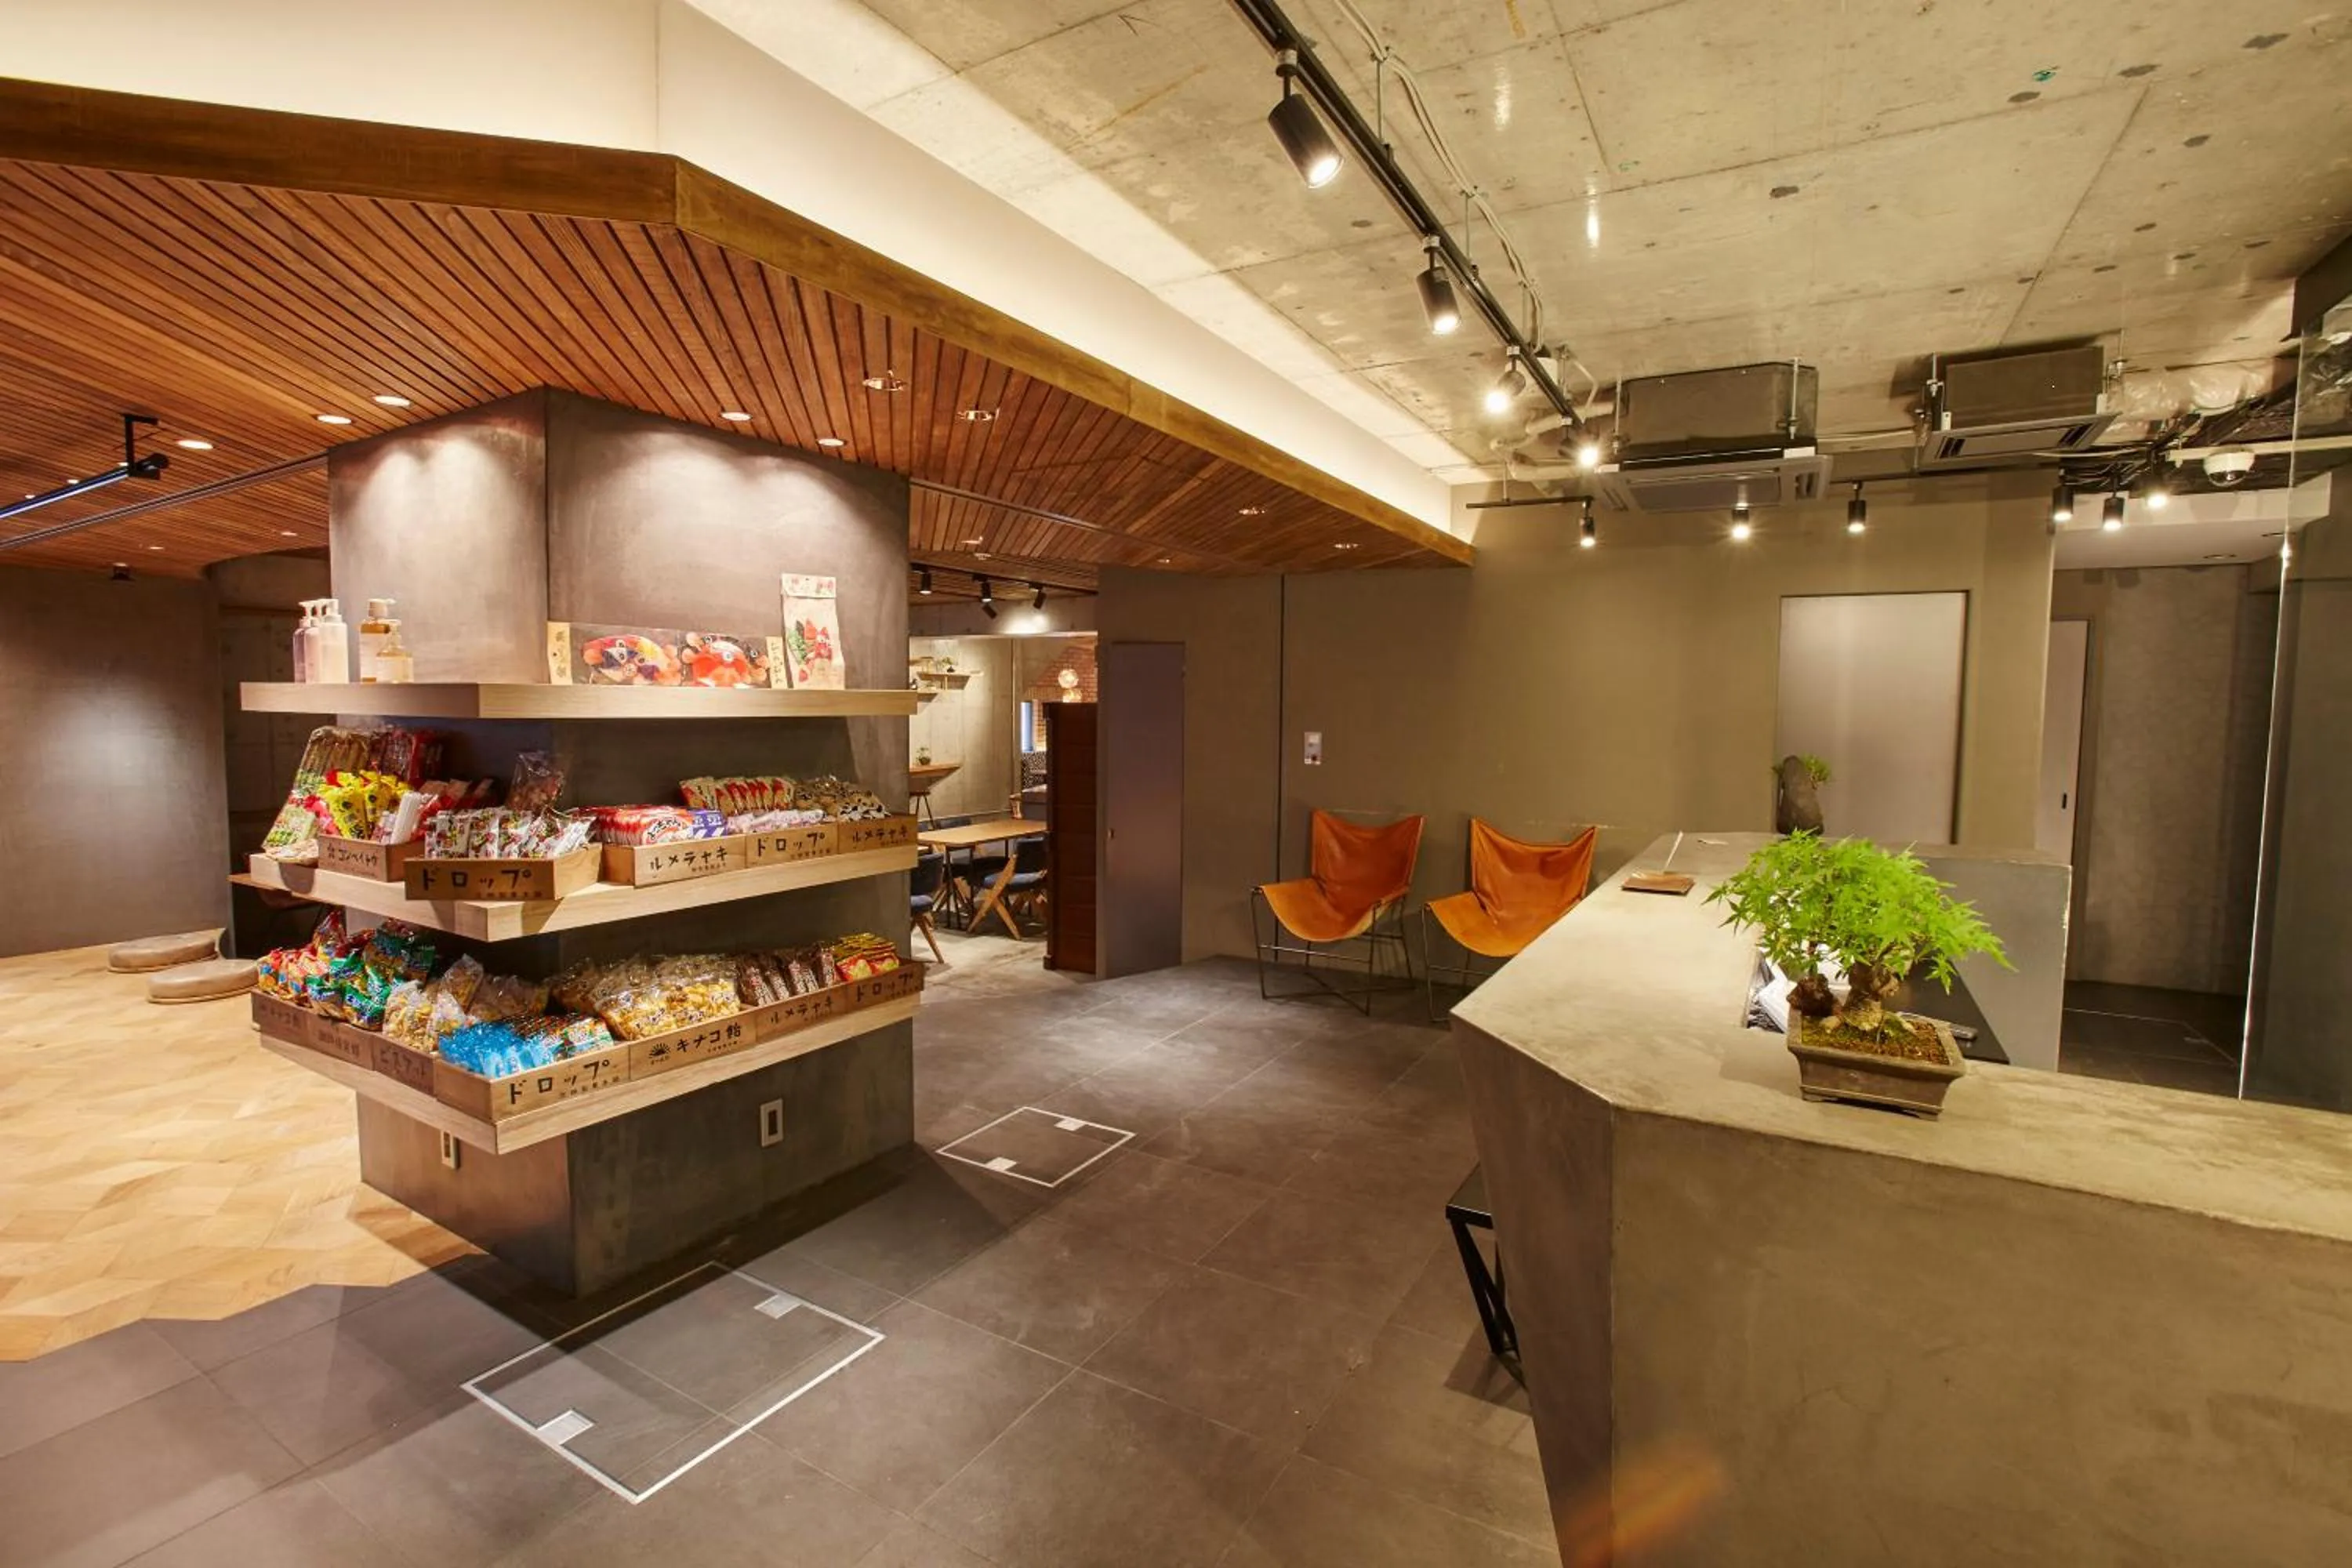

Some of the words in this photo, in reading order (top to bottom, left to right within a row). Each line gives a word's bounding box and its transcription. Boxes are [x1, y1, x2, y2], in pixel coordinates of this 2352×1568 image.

[757, 831, 826, 858] ドロップ
[422, 866, 532, 891] ドロップ
[676, 1022, 742, 1053] キナコ飴
[509, 1058, 611, 1105] ドロップ
